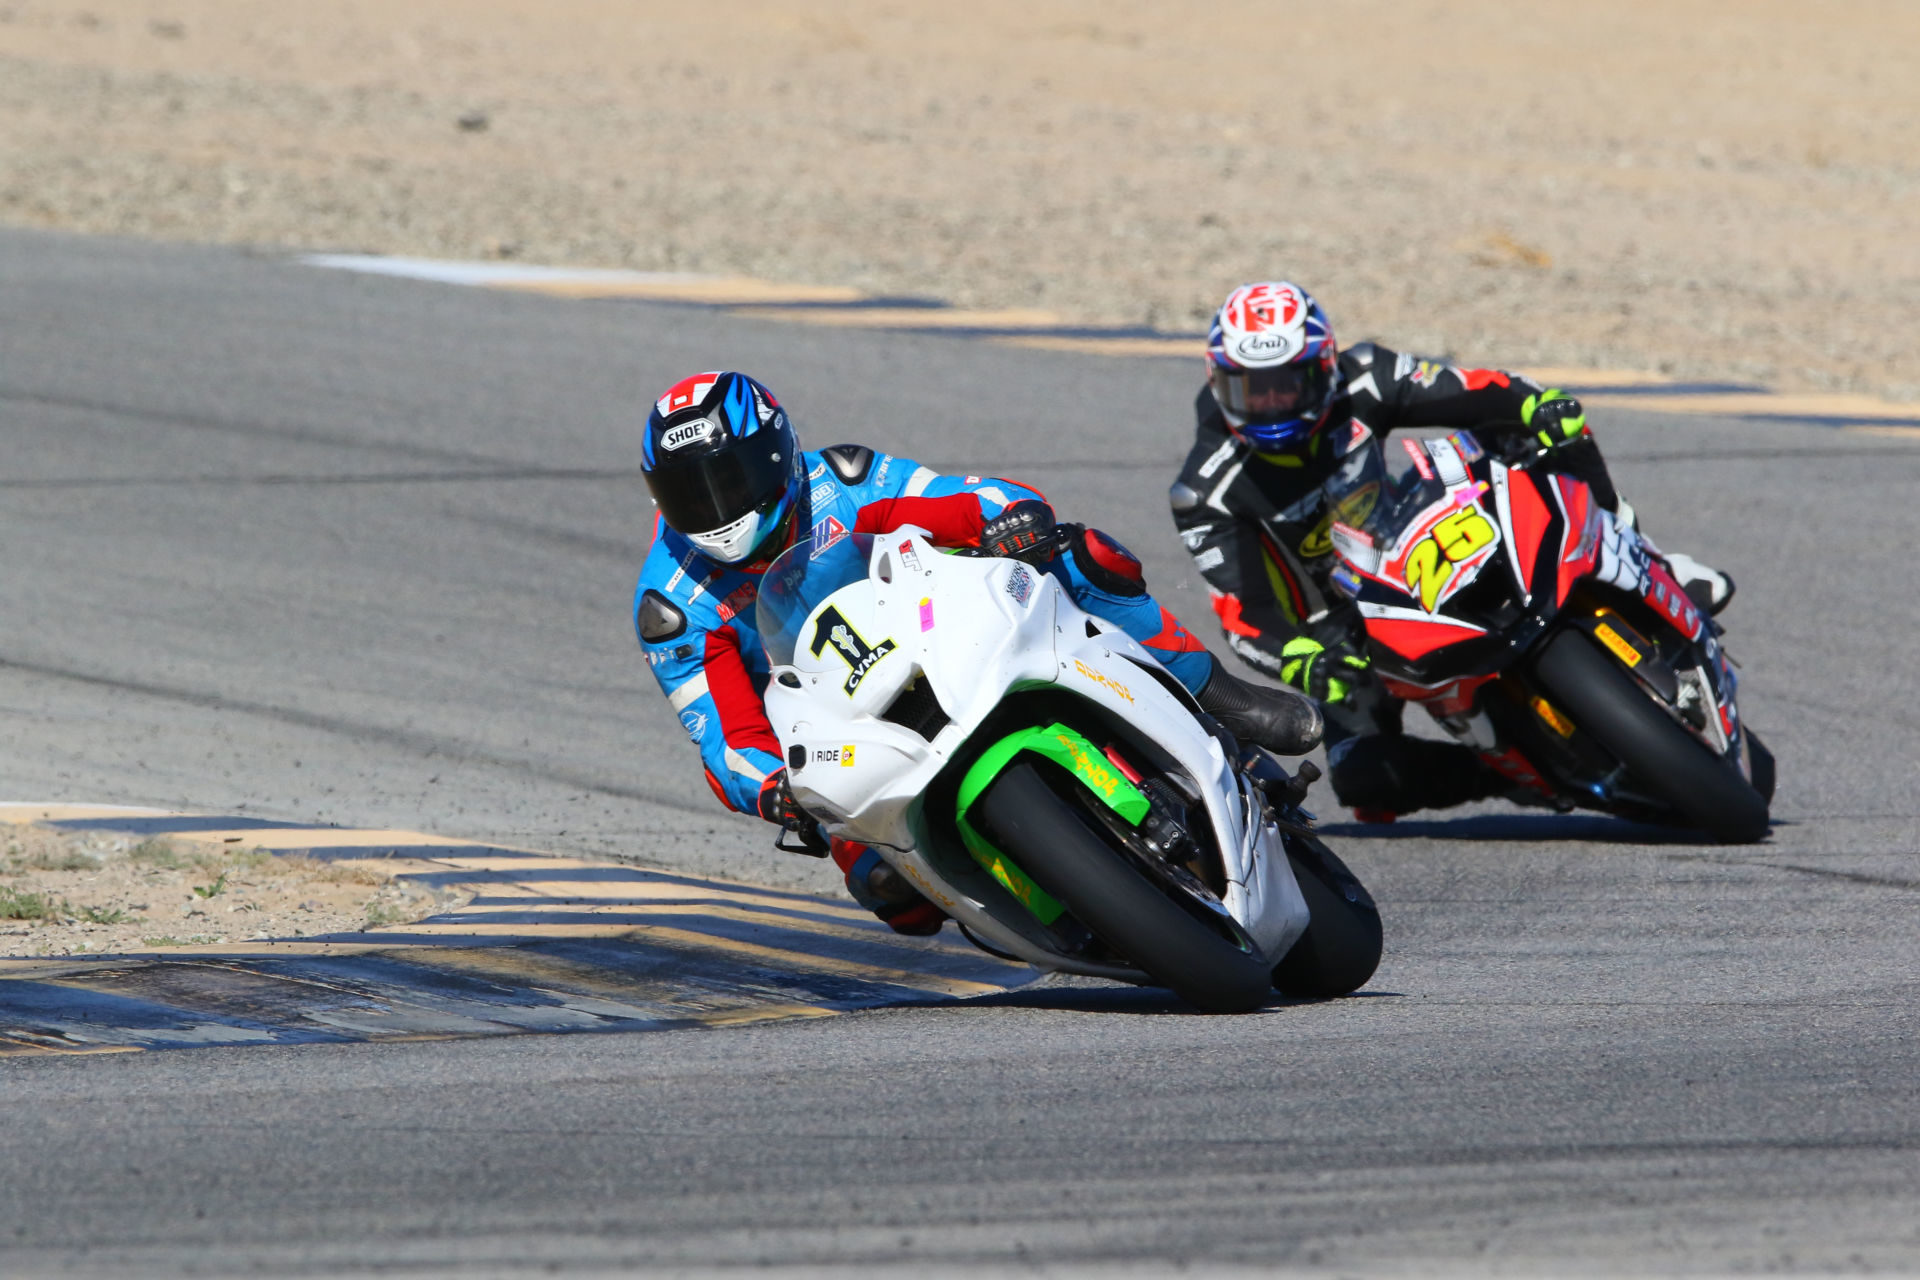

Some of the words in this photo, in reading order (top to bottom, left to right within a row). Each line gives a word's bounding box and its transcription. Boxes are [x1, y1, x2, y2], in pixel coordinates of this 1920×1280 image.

[1404, 503, 1496, 615] 25
[810, 602, 899, 700] 1
[847, 645, 889, 689] CVMA
[816, 749, 839, 762] RIDE
